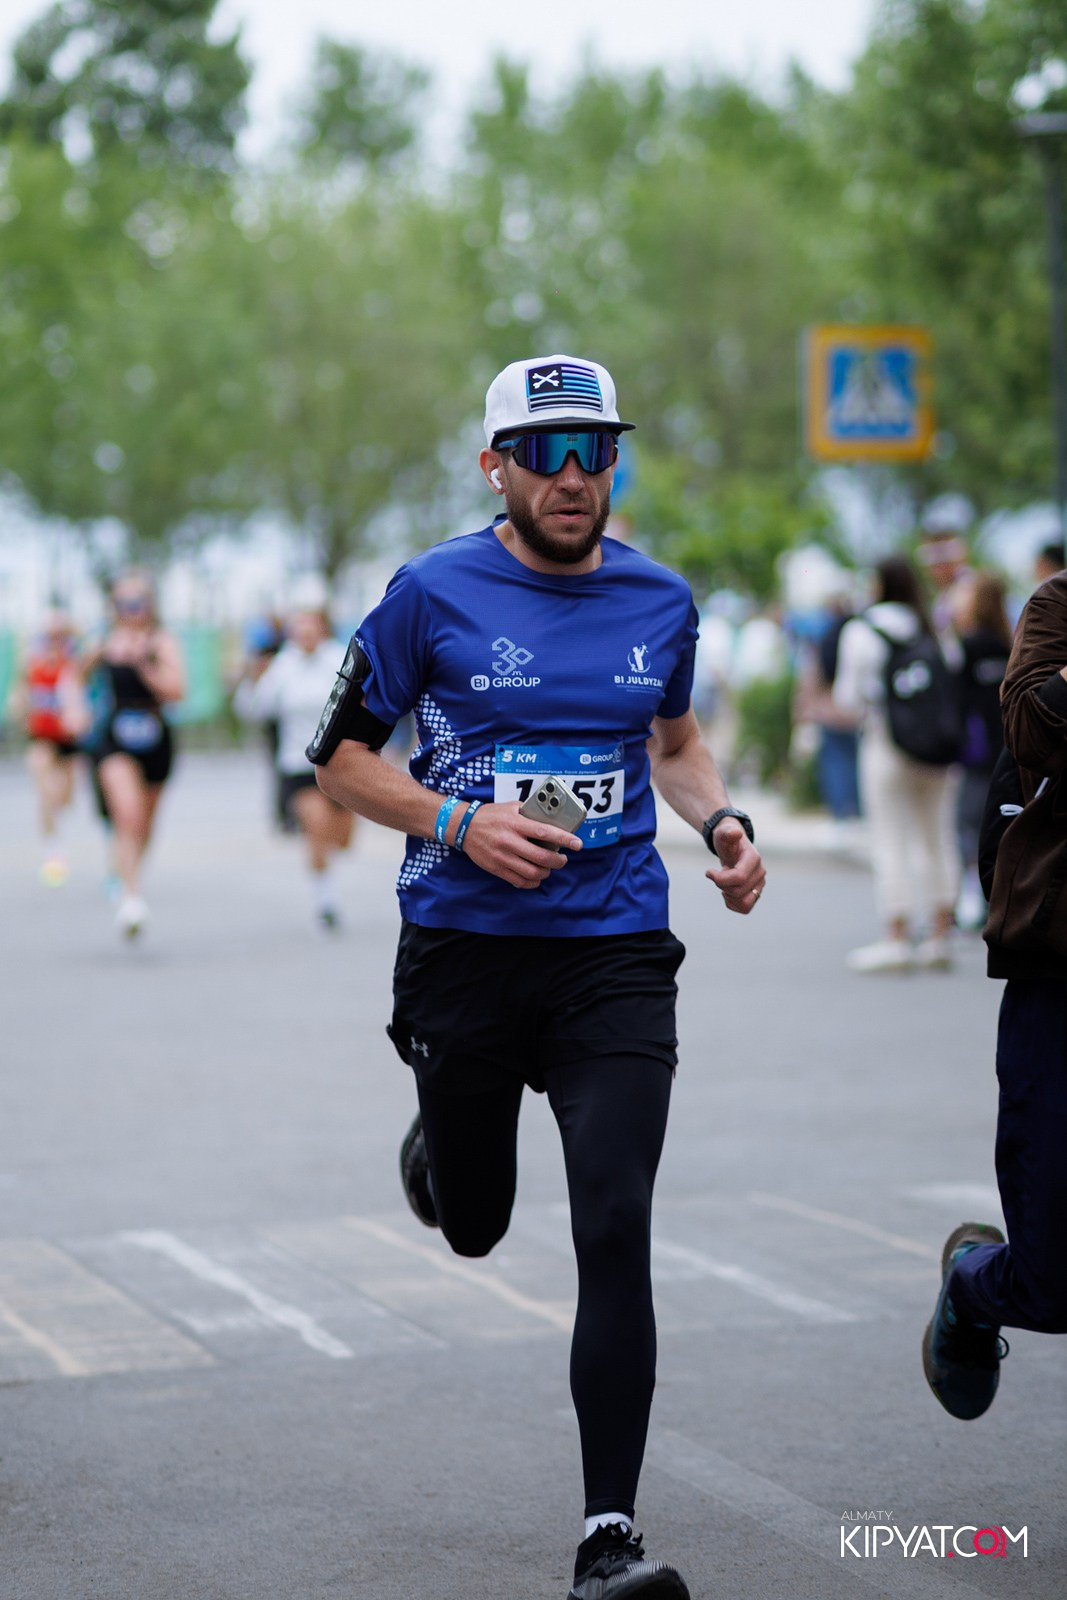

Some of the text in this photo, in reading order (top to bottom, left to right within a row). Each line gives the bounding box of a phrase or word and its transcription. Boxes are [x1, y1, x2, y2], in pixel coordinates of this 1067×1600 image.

[492, 677, 541, 687] GROUP
[614, 675, 624, 684] BI
[502, 750, 537, 763] 5 KM
[592, 753, 613, 762] GROUP
[516, 776, 615, 814] 153
